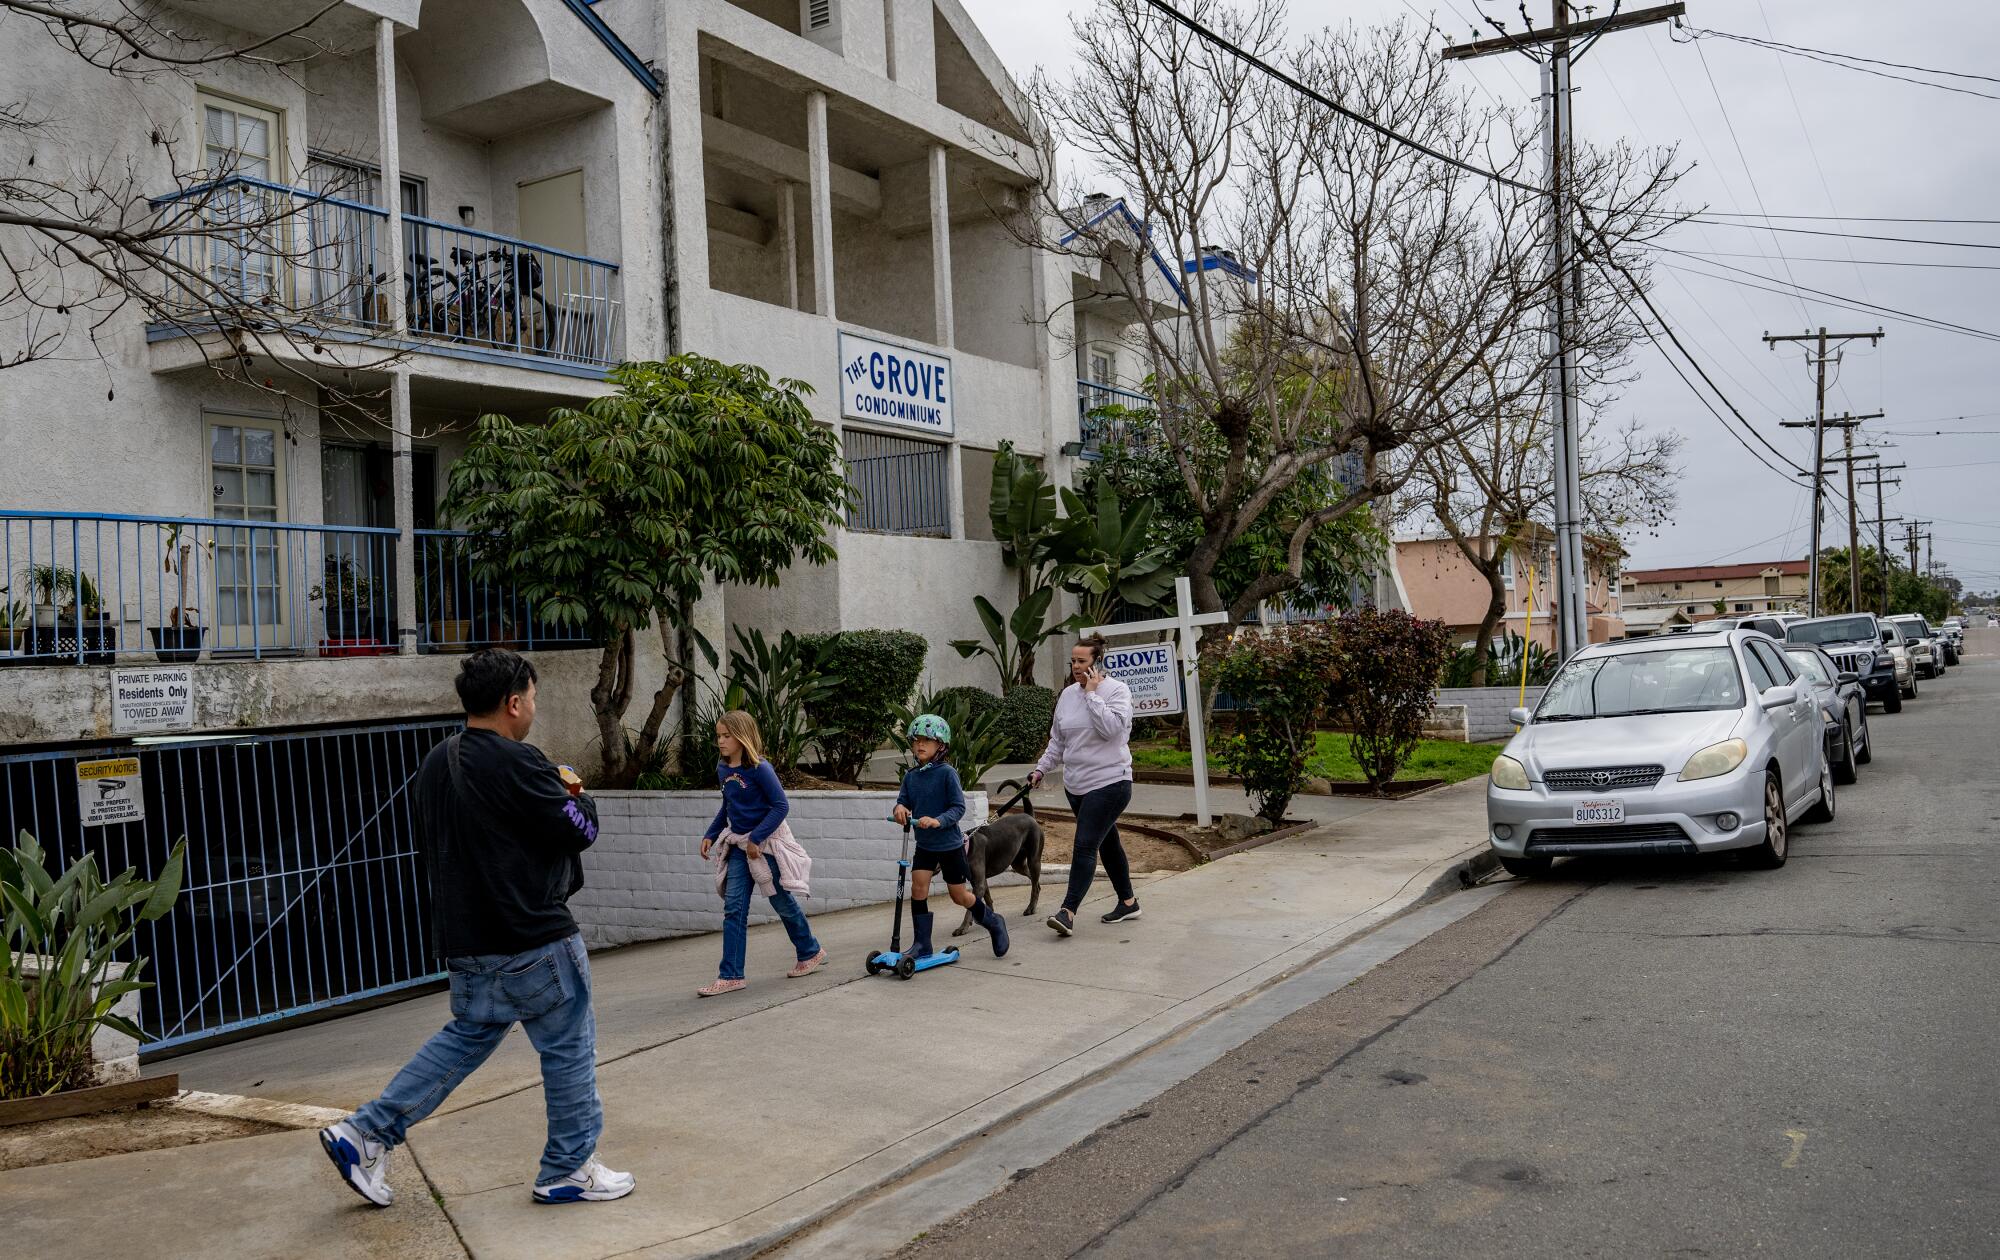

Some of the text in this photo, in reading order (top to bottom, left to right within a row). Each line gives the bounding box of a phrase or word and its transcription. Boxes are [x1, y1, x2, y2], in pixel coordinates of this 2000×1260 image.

[845, 351, 946, 404] THE GROVE
[855, 394, 941, 426] CONDOMINIUMS
[1104, 649, 1168, 670] GROVE
[118, 672, 187, 684] PRIVATE PARKING
[1127, 676, 1164, 686] BEDROOMS
[119, 685, 188, 700] Residents Only
[123, 705, 185, 719] TOWED AWAY
[79, 762, 137, 777] SECURITY NOTICE
[105, 798, 131, 806] PROPERTY
[97, 805, 126, 814] PROTECTED
[104, 810, 139, 820] SURVEILLANCE
[1576, 808, 1620, 820] 8UQS312
